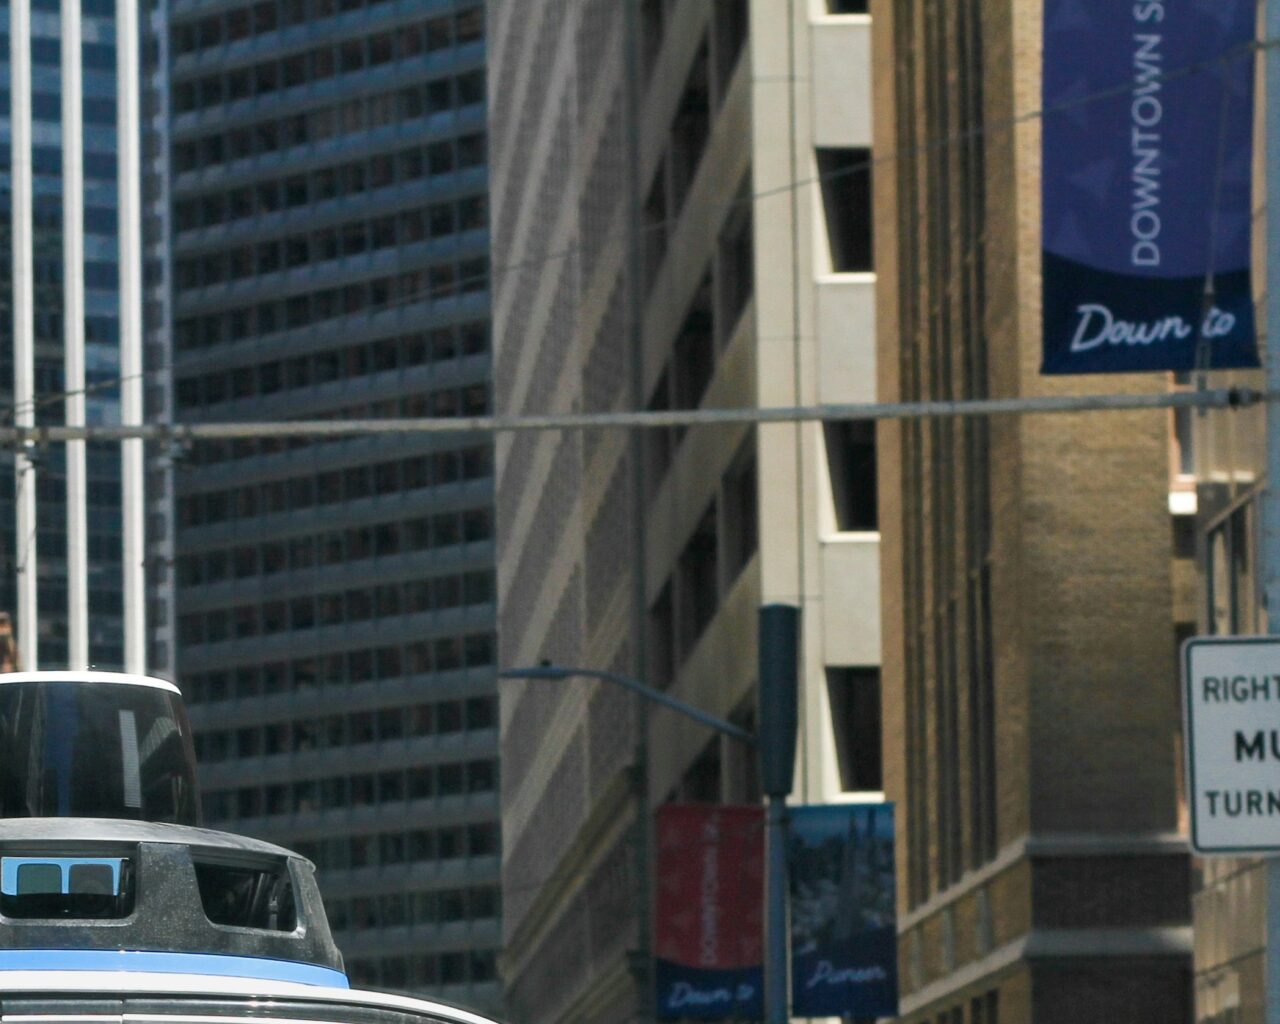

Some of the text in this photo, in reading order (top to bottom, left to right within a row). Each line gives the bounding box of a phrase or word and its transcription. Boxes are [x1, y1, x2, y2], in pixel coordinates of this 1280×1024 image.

[1131, 0, 1165, 267] DOWNTOWN S
[1070, 304, 1237, 352] Down to
[1205, 790, 1280, 818] TURN
